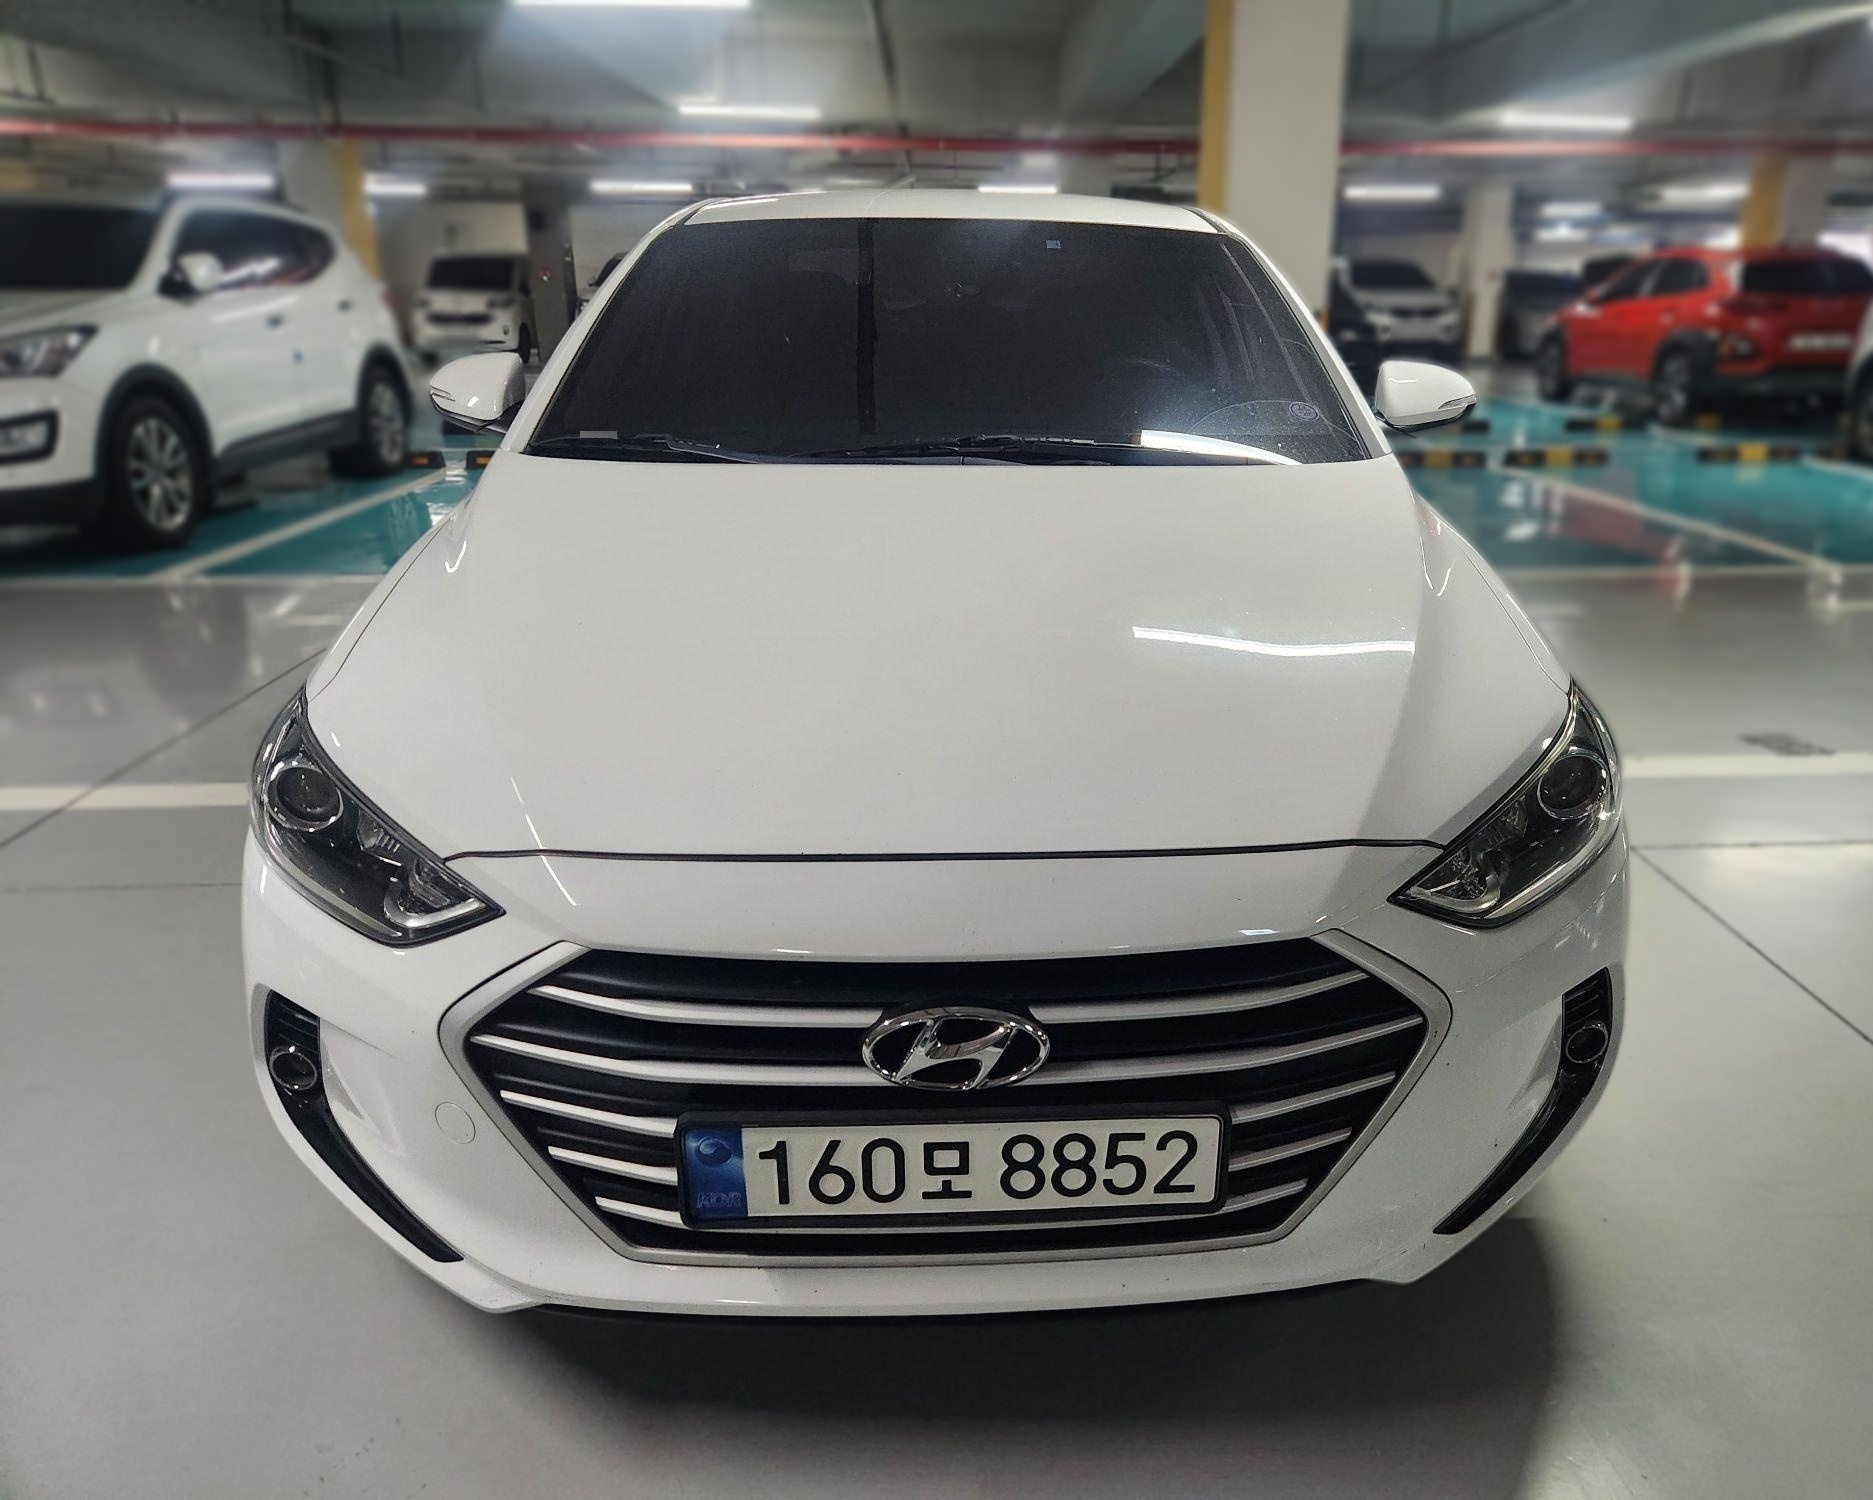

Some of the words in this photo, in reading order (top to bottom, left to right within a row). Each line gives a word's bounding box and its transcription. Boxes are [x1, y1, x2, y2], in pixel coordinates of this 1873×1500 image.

[758, 1138, 973, 1206] 160모
[999, 1129, 1199, 1200] 8852
[696, 1191, 742, 1209] KOR
